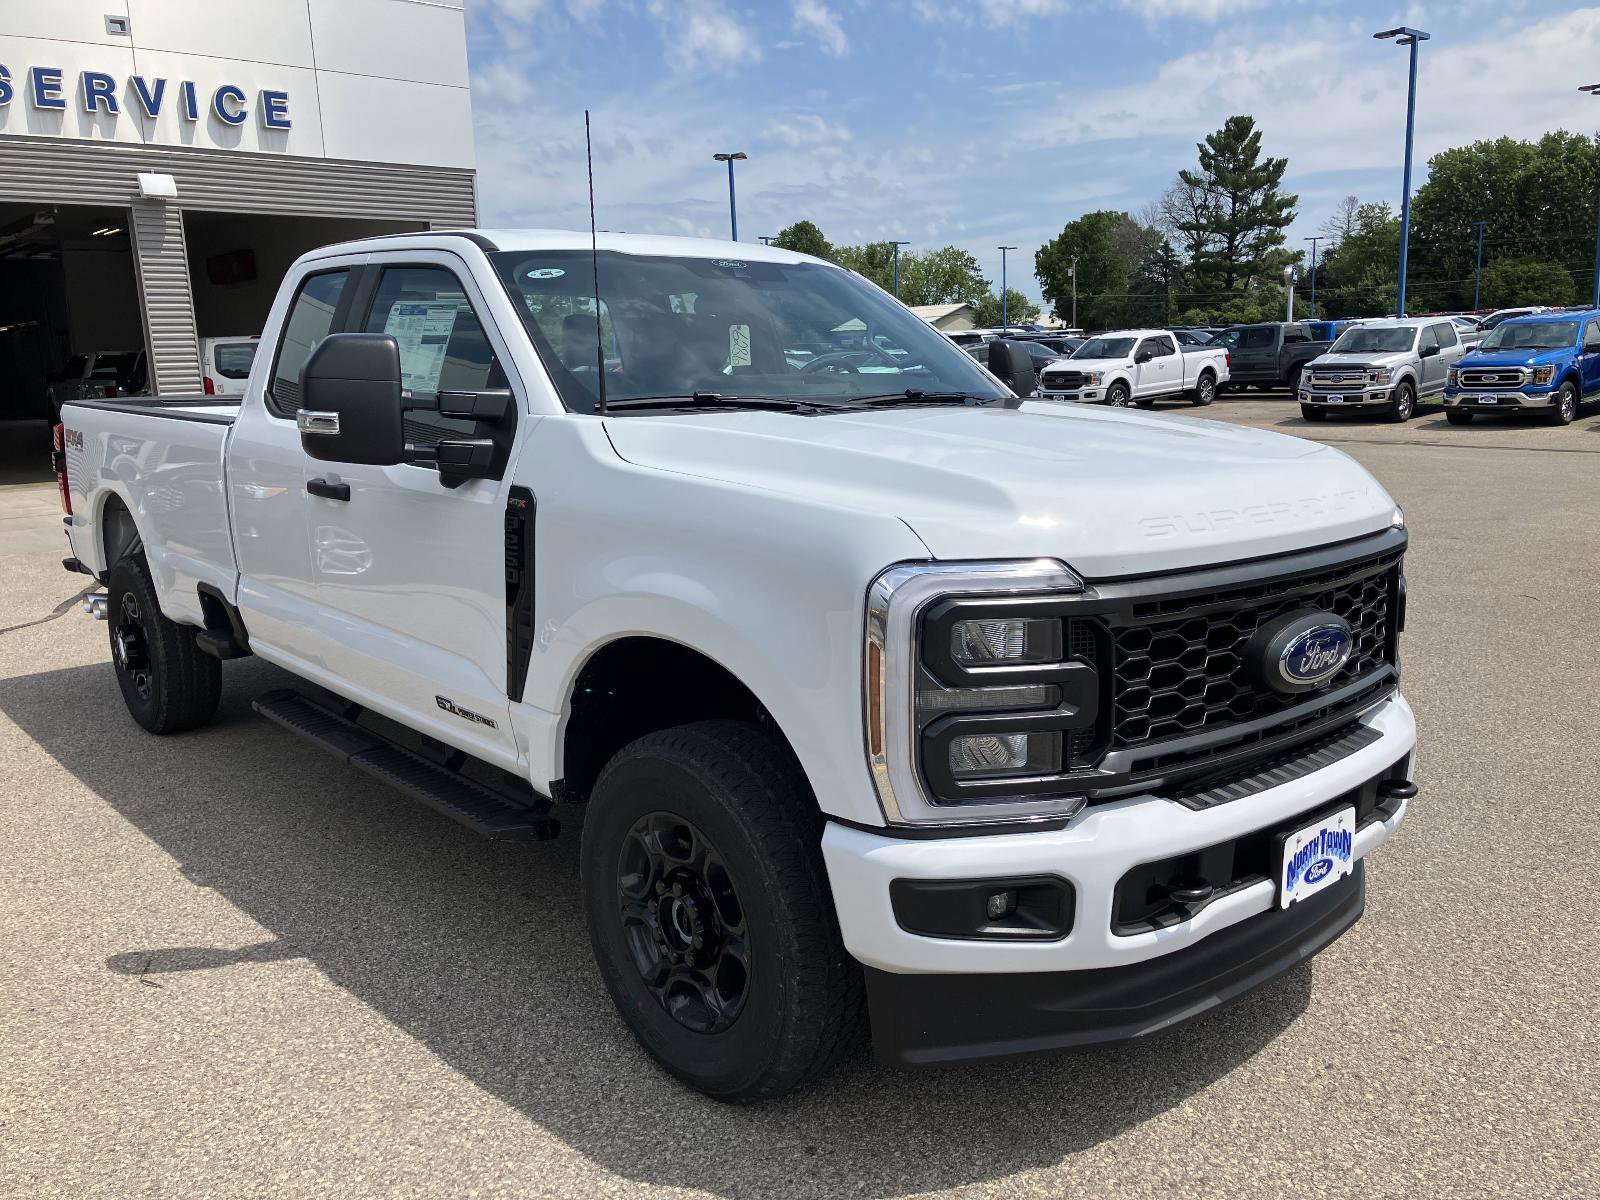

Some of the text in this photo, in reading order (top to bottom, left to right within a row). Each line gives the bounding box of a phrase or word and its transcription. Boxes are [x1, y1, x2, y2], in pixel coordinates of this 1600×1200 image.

[1299, 636, 1341, 673] Ford
[1286, 827, 1352, 890] NORTH TOWN
[1308, 861, 1329, 880] Ford
